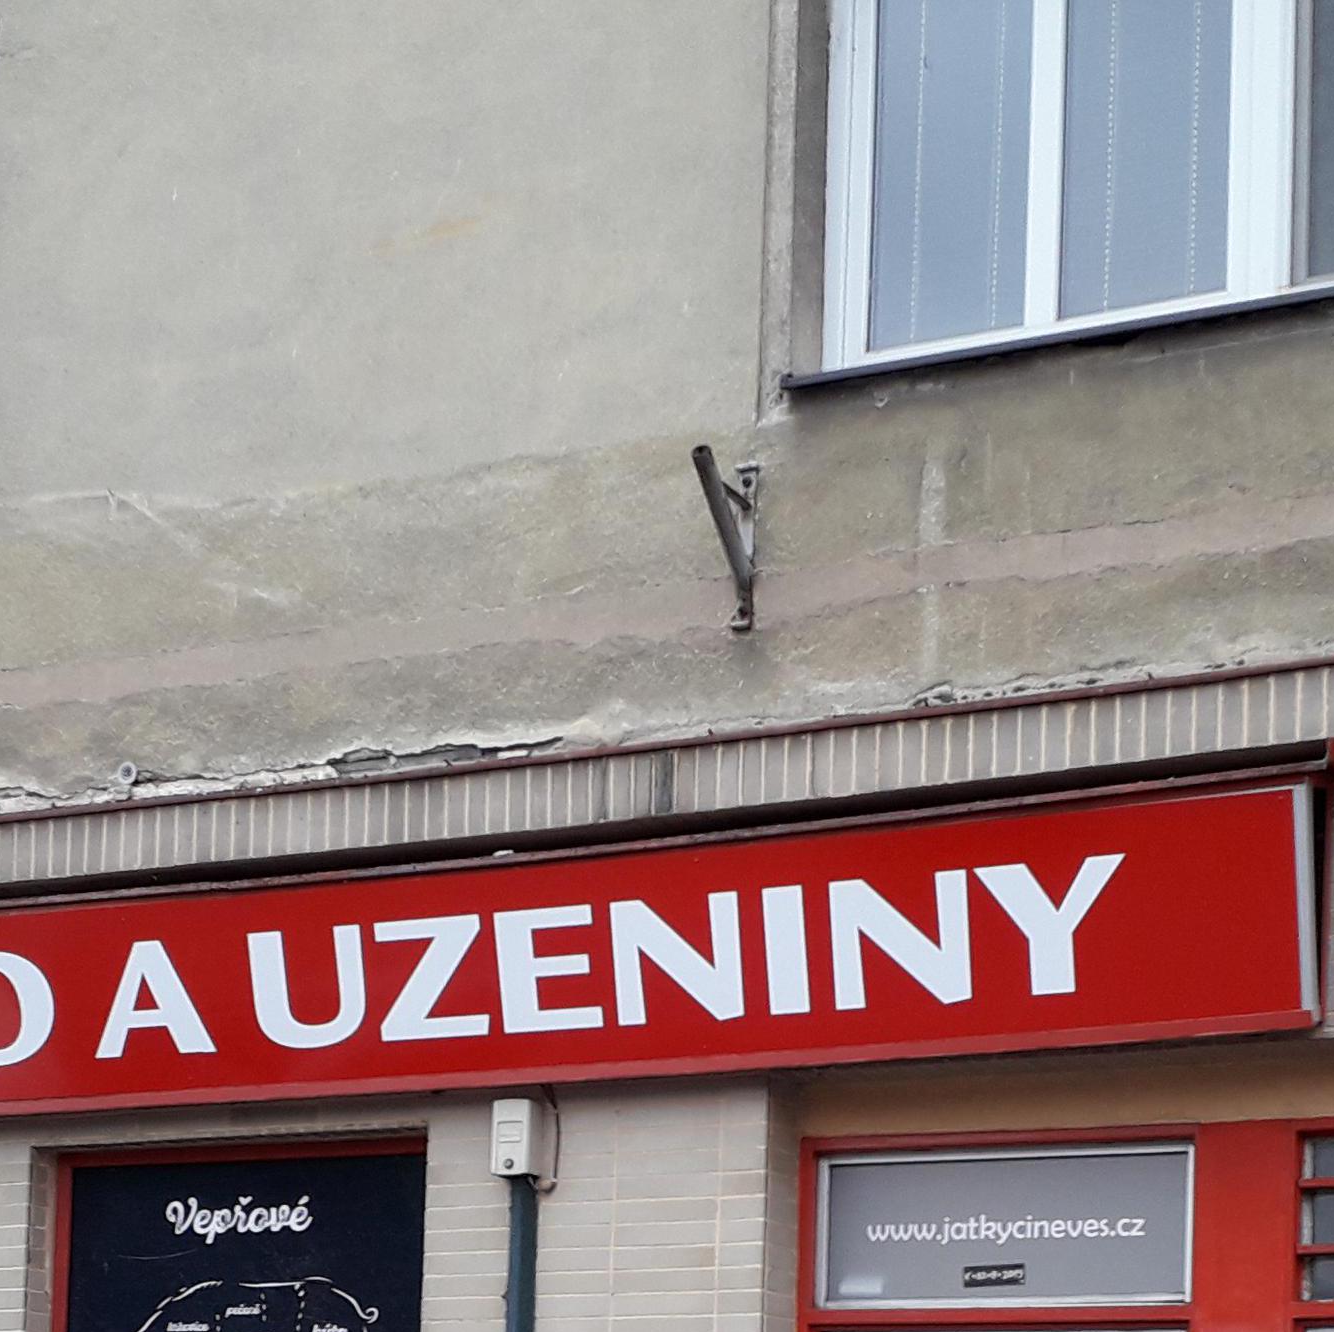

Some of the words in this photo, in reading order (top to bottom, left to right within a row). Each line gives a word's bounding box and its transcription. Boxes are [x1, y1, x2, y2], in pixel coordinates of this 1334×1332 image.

[94, 940, 218, 1060] A
[247, 852, 1126, 1050] UZENINY
[164, 1194, 314, 1244] Vepřové
[865, 1212, 1147, 1249] www.jatkycineves.cz
